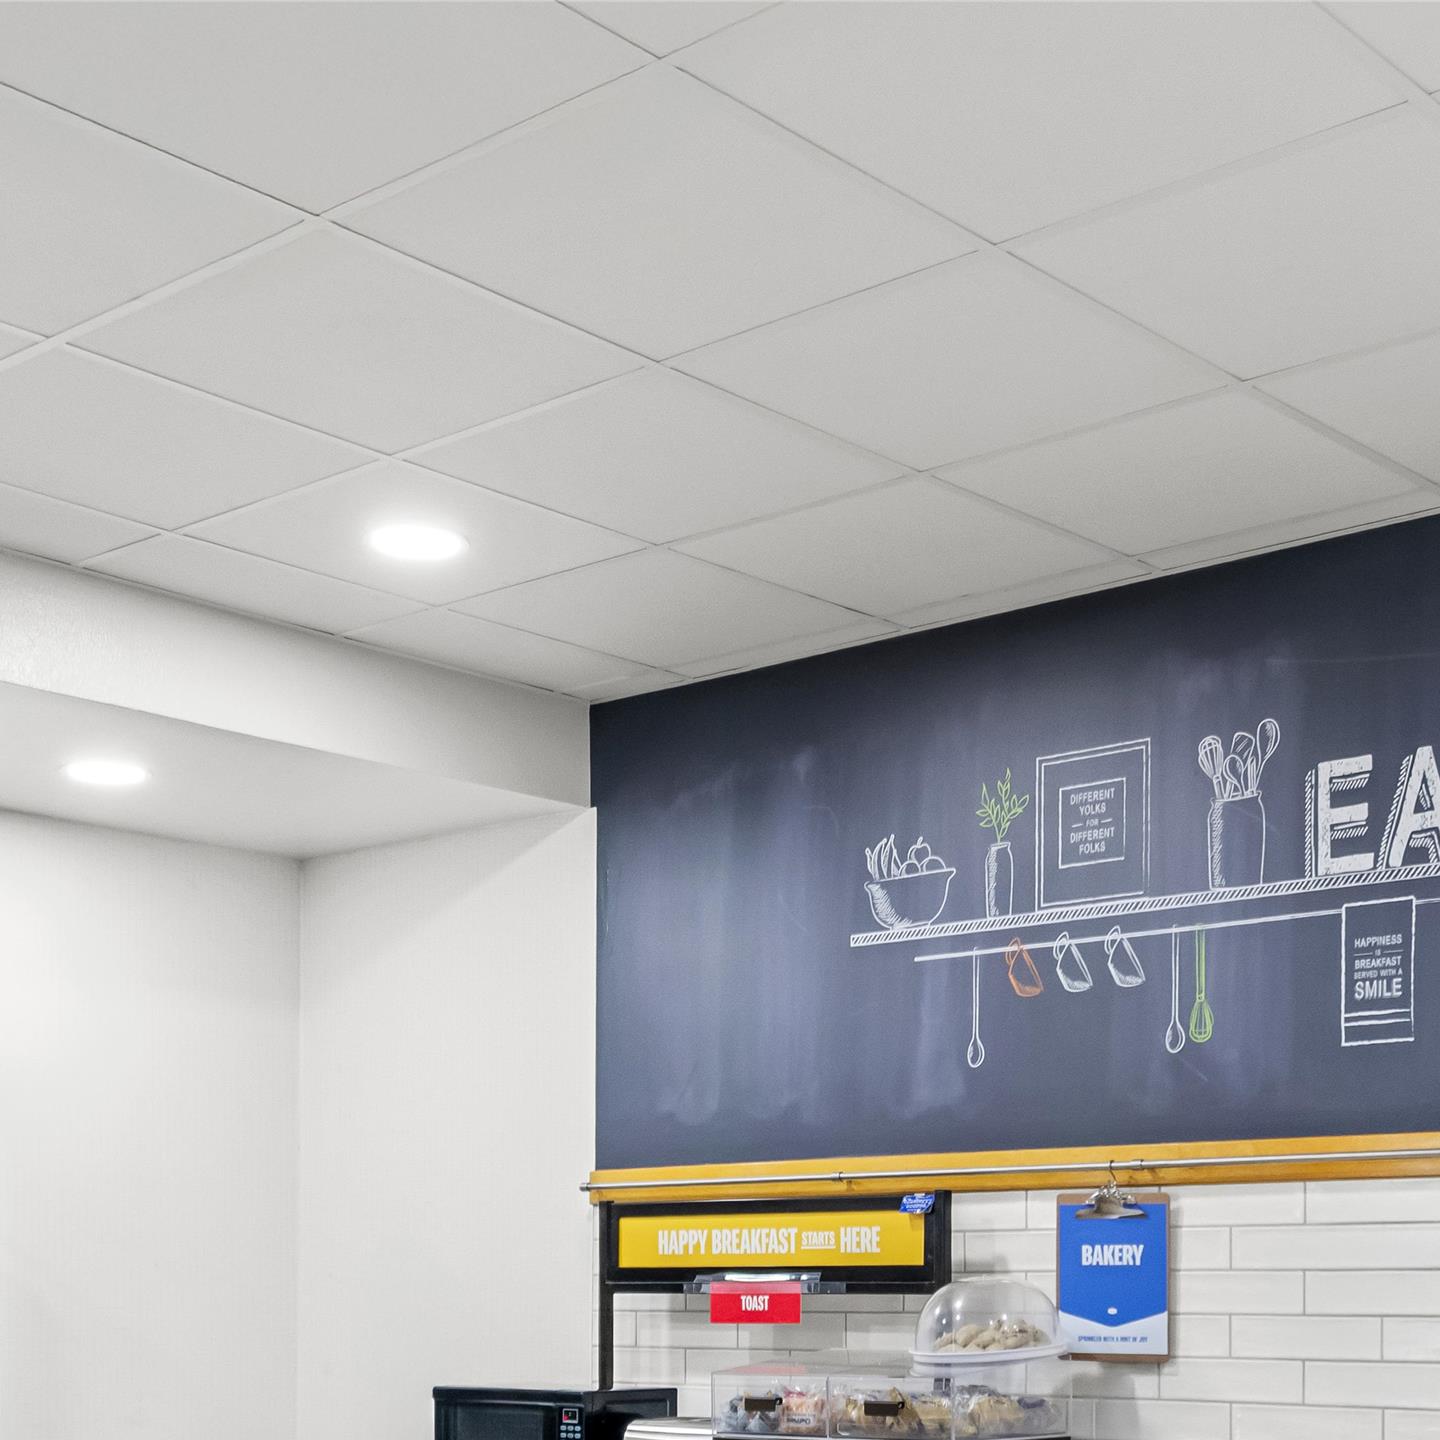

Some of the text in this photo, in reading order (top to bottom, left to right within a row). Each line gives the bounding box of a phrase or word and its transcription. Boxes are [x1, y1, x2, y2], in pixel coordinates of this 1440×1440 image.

[1070, 788, 1115, 805] DIFFERENT
[1079, 802, 1106, 816] YOLKS
[1086, 819, 1099, 827] FOR
[1070, 827, 1115, 844] DIFFERENT
[1079, 841, 1106, 855] FOLKS
[1354, 933, 1402, 949] HAPPINESS
[1375, 948, 1381, 956] IS
[1355, 956, 1402, 970] BREAKFAST
[1354, 967, 1403, 980] SERVED WITH A
[1354, 978, 1403, 1001] SMILE
[658, 1226, 881, 1255] HAPPY BREAKFAST STARTS HERE
[1081, 1244, 1145, 1267] BAKERY
[741, 1296, 769, 1311] TOAST
